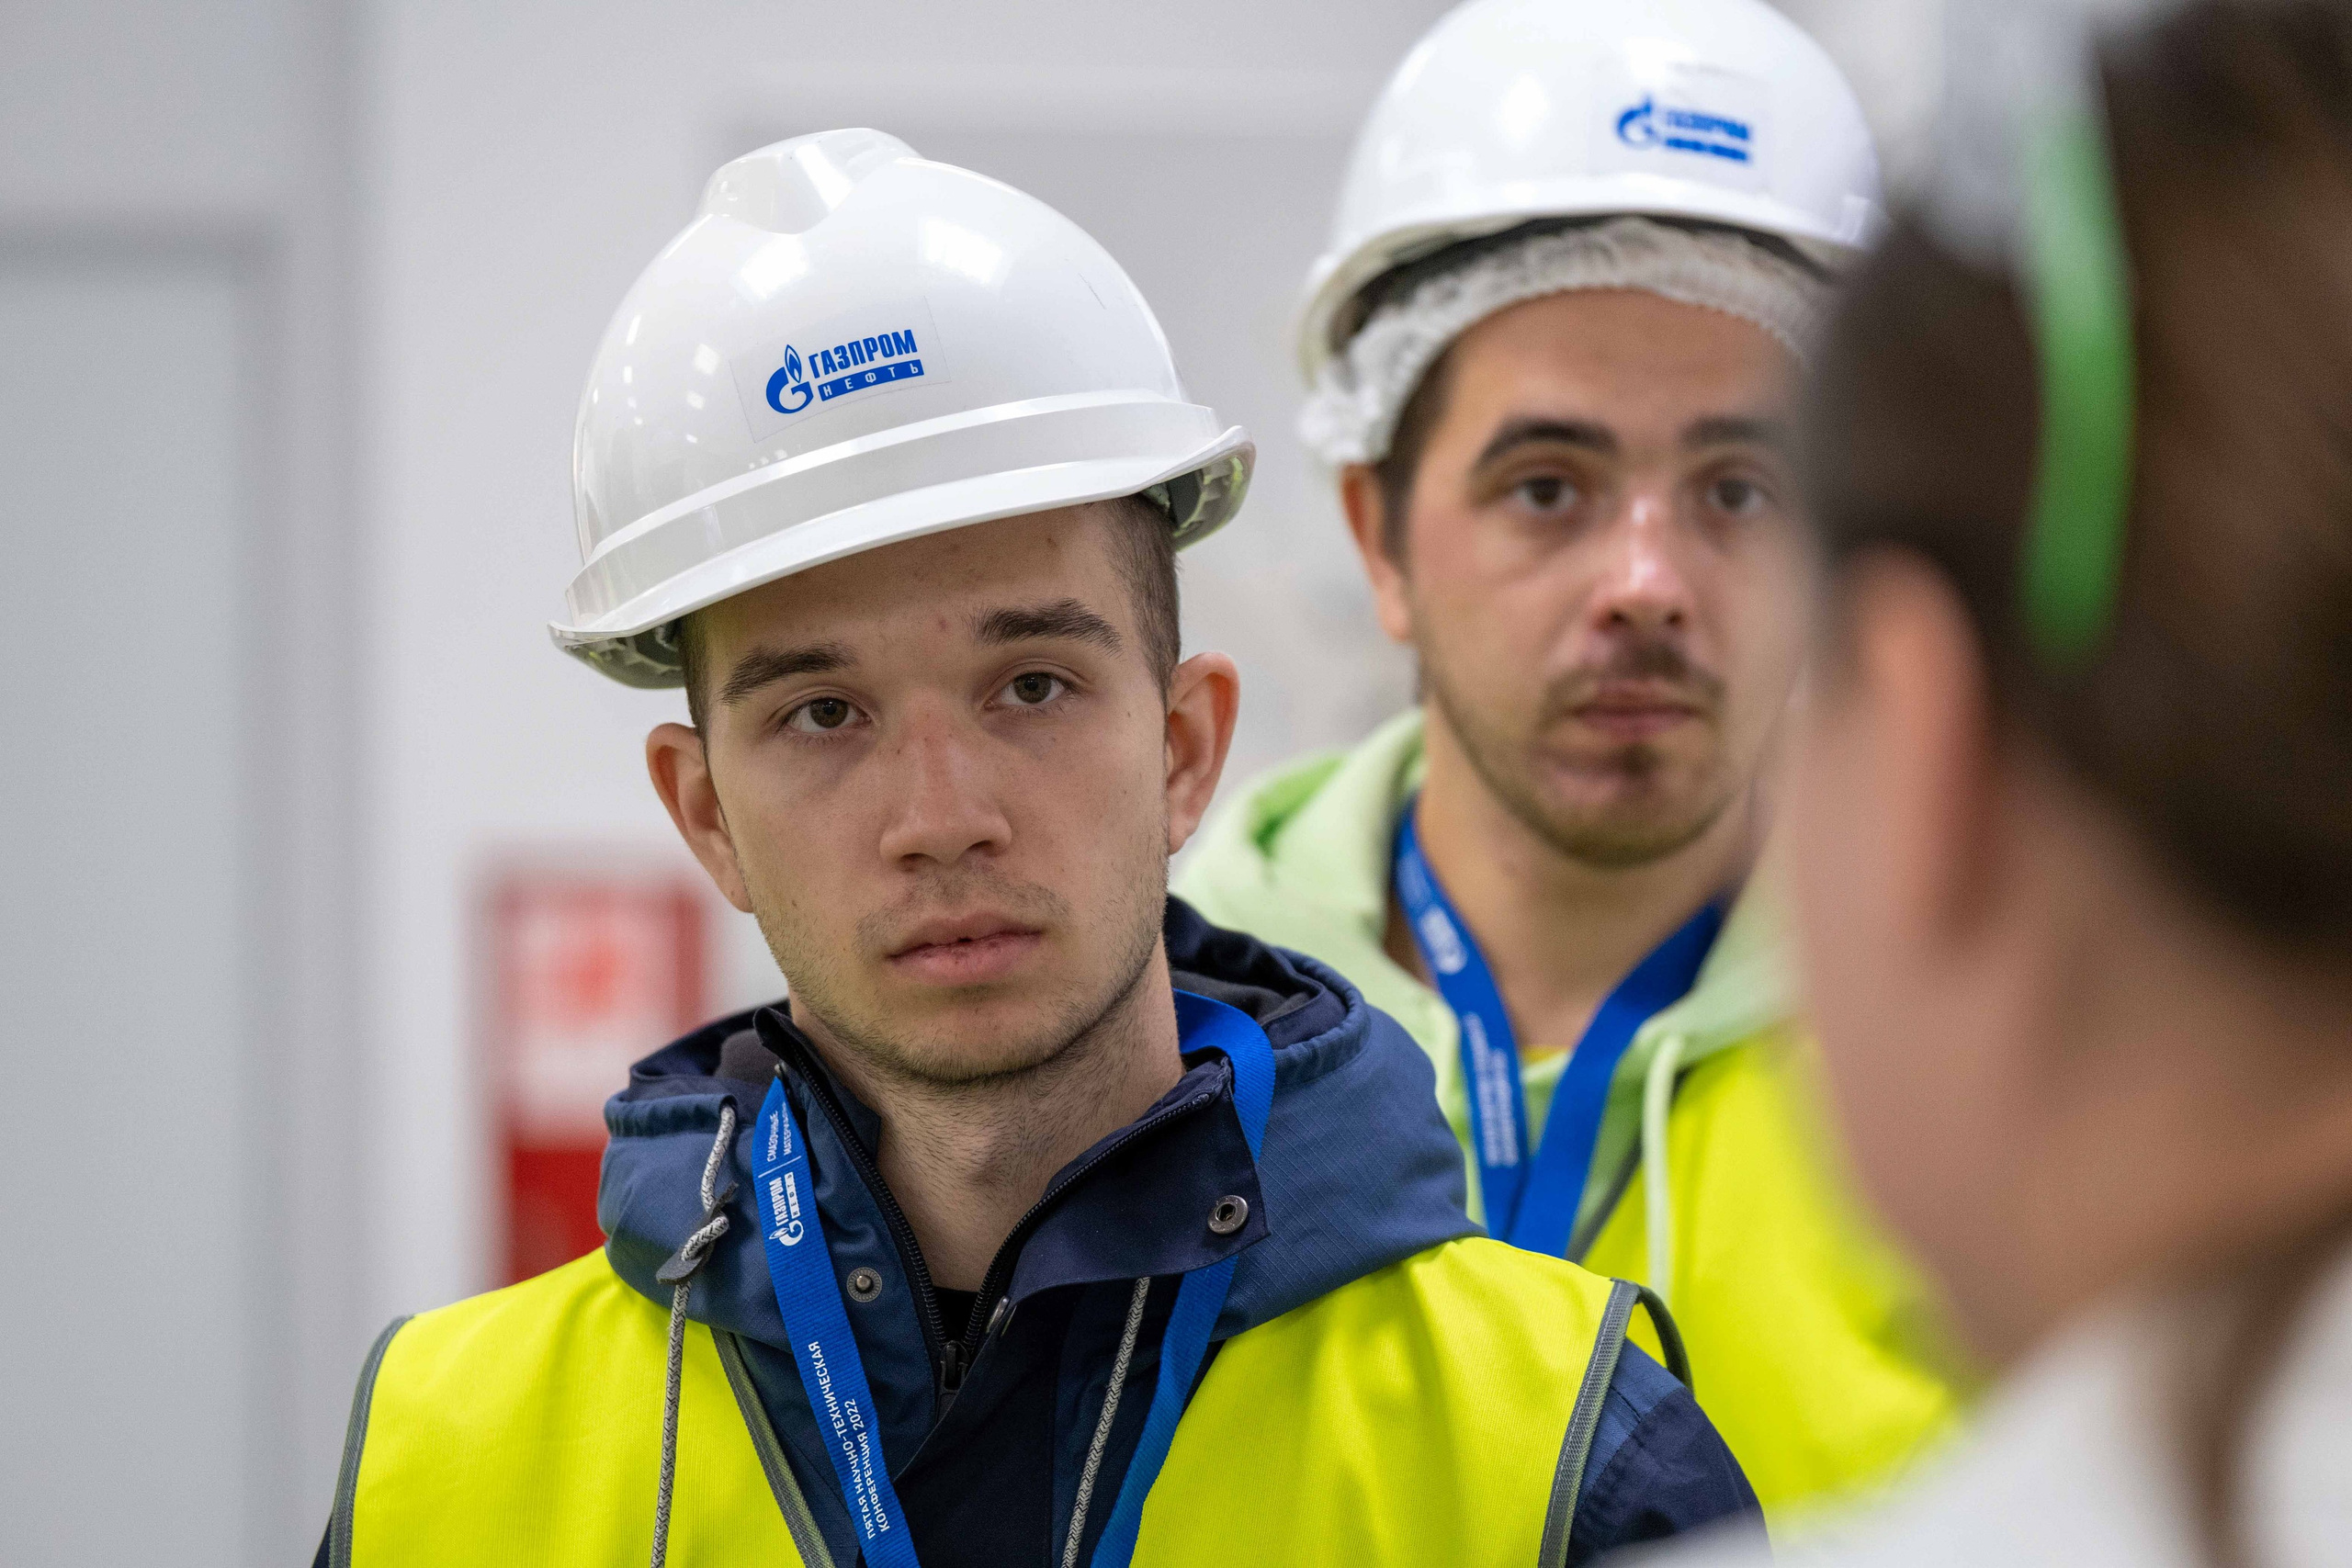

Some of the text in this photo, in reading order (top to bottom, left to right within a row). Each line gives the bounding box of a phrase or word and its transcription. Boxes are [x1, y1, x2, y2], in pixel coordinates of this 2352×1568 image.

[808, 329, 918, 378] ГАЗПРОМ
[822, 362, 920, 397] НЕФТЬ
[769, 1177, 789, 1227] ГАЗПРОМ
[786, 1173, 799, 1217] НЕФТЬ
[808, 1341, 876, 1540] ПЯТАЯ НАУЧНО-ТЕХНИЧЕСКАЯ
[843, 1398, 890, 1532] КОНФЕРЕНЦИЯ 2022
